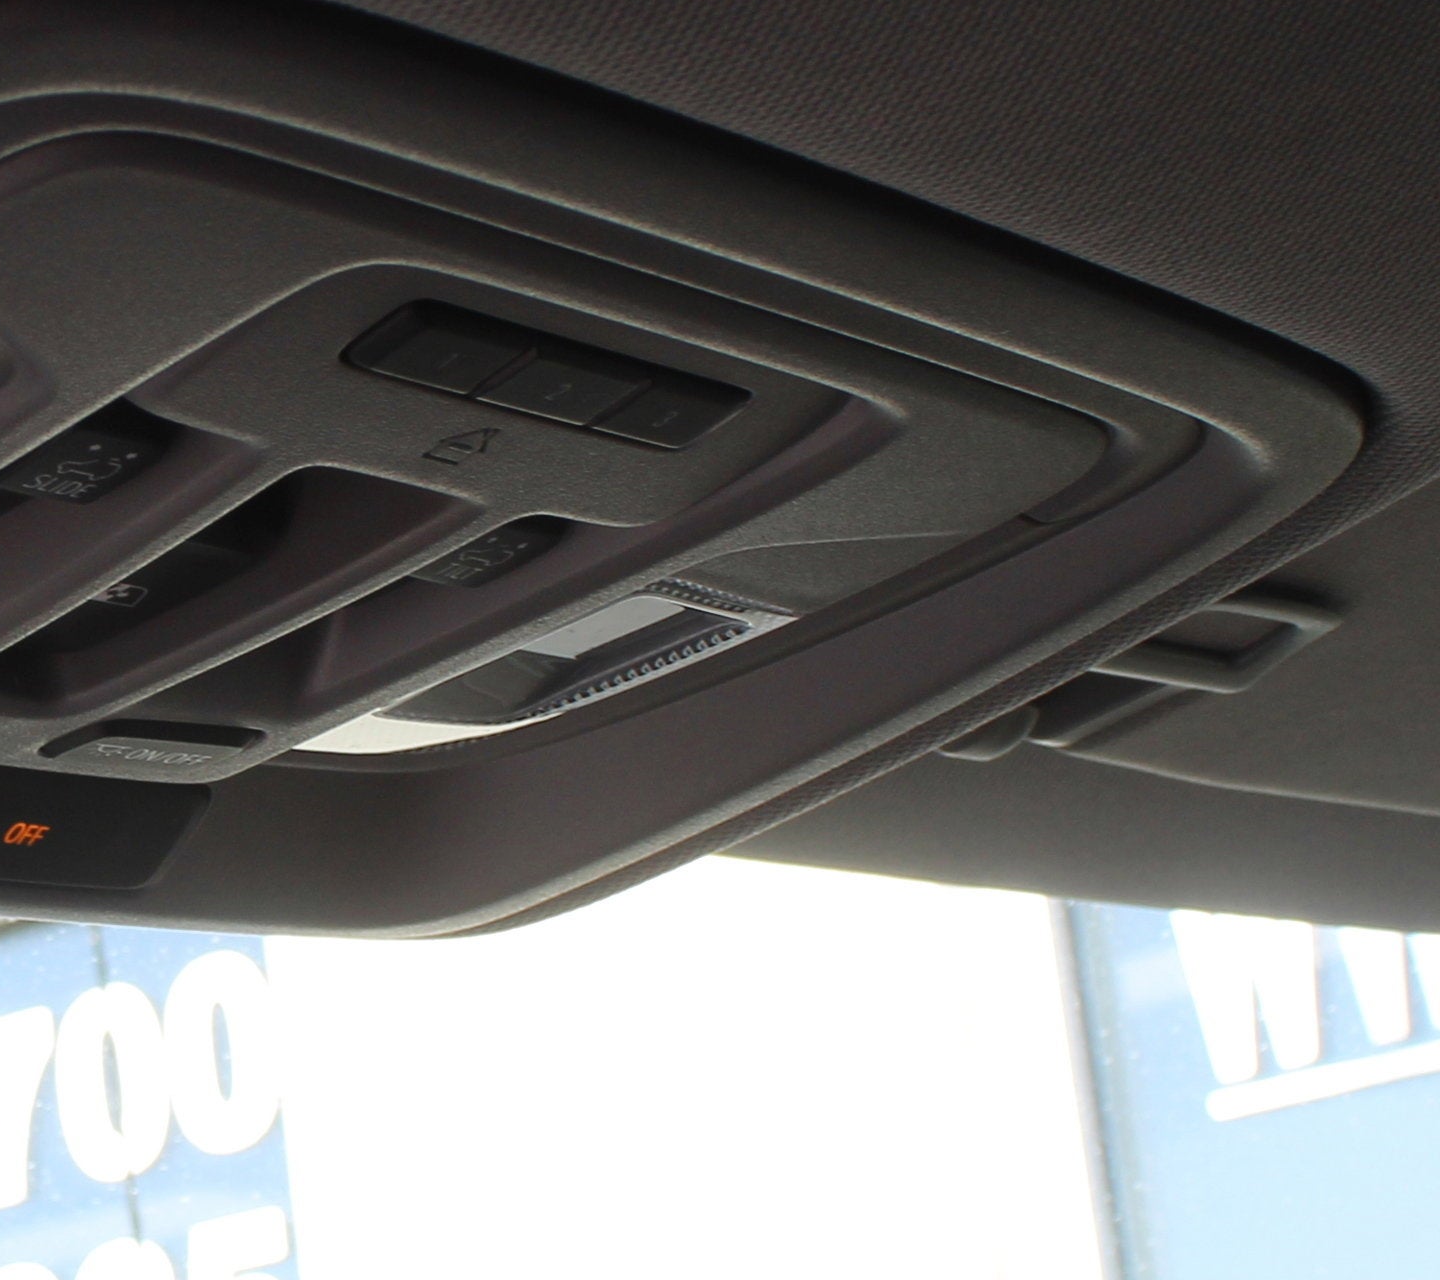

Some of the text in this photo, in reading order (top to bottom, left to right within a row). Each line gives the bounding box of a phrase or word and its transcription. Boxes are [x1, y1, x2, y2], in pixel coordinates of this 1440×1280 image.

[22, 473, 98, 499] SLIDE
[124, 748, 213, 767] ON/OFF
[2, 820, 51, 847] OFF
